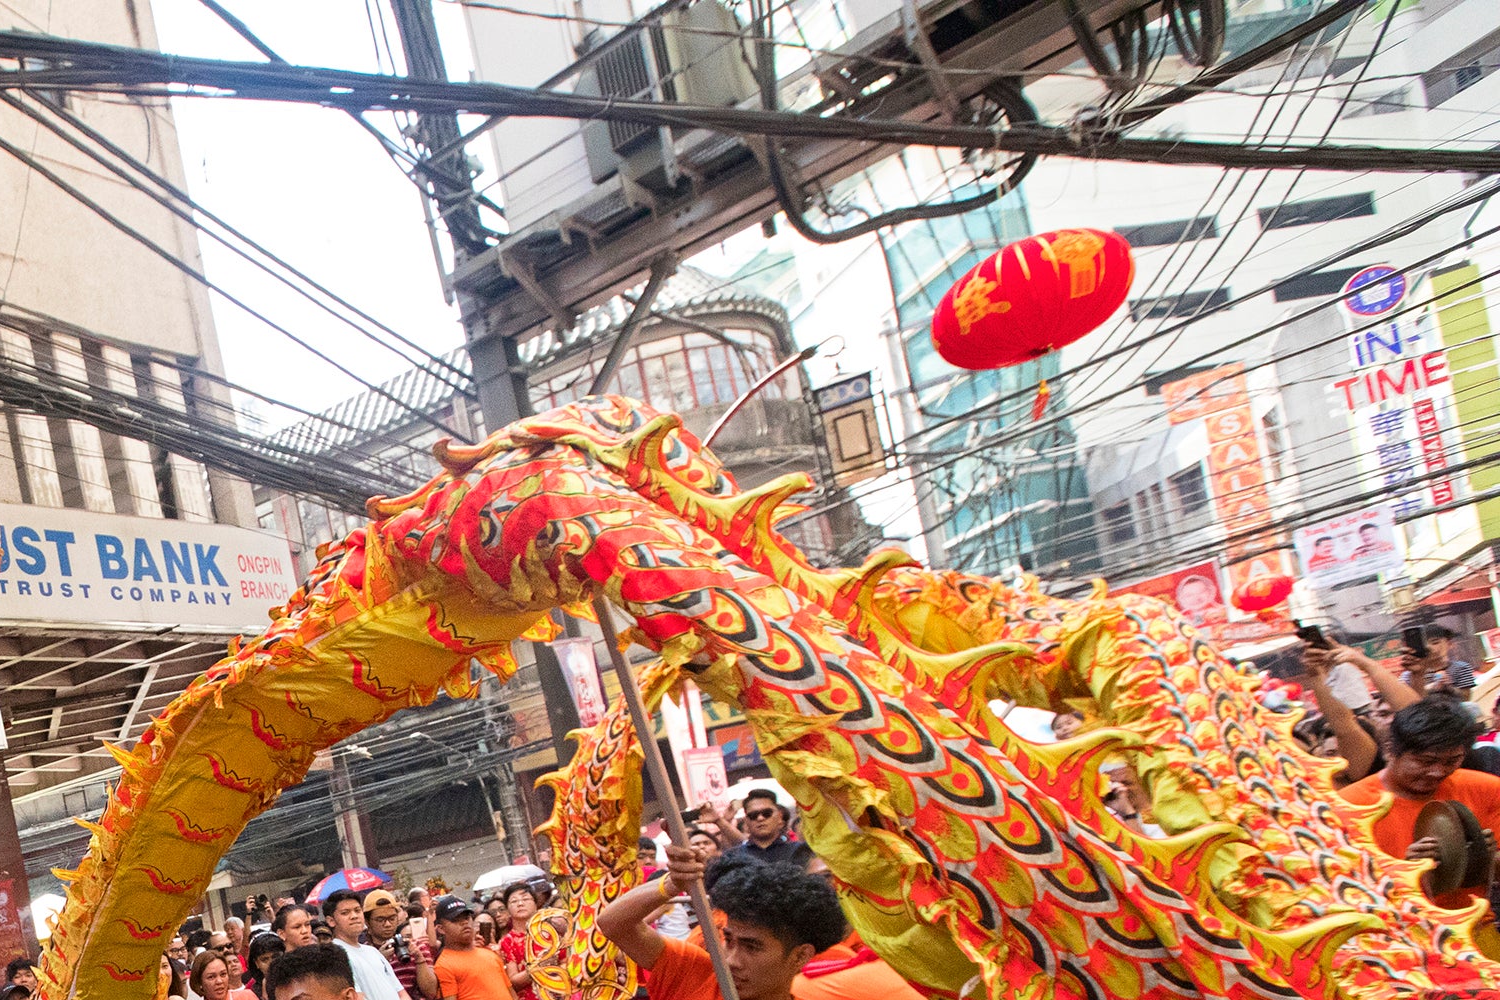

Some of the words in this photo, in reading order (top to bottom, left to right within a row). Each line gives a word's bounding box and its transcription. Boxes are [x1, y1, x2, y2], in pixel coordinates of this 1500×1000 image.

[1334, 351, 1450, 411] TIME
[94, 533, 229, 587] BANK
[237, 553, 282, 576] ONGPIN
[110, 585, 232, 607] COMPANY
[241, 579, 289, 601] BRANCH
